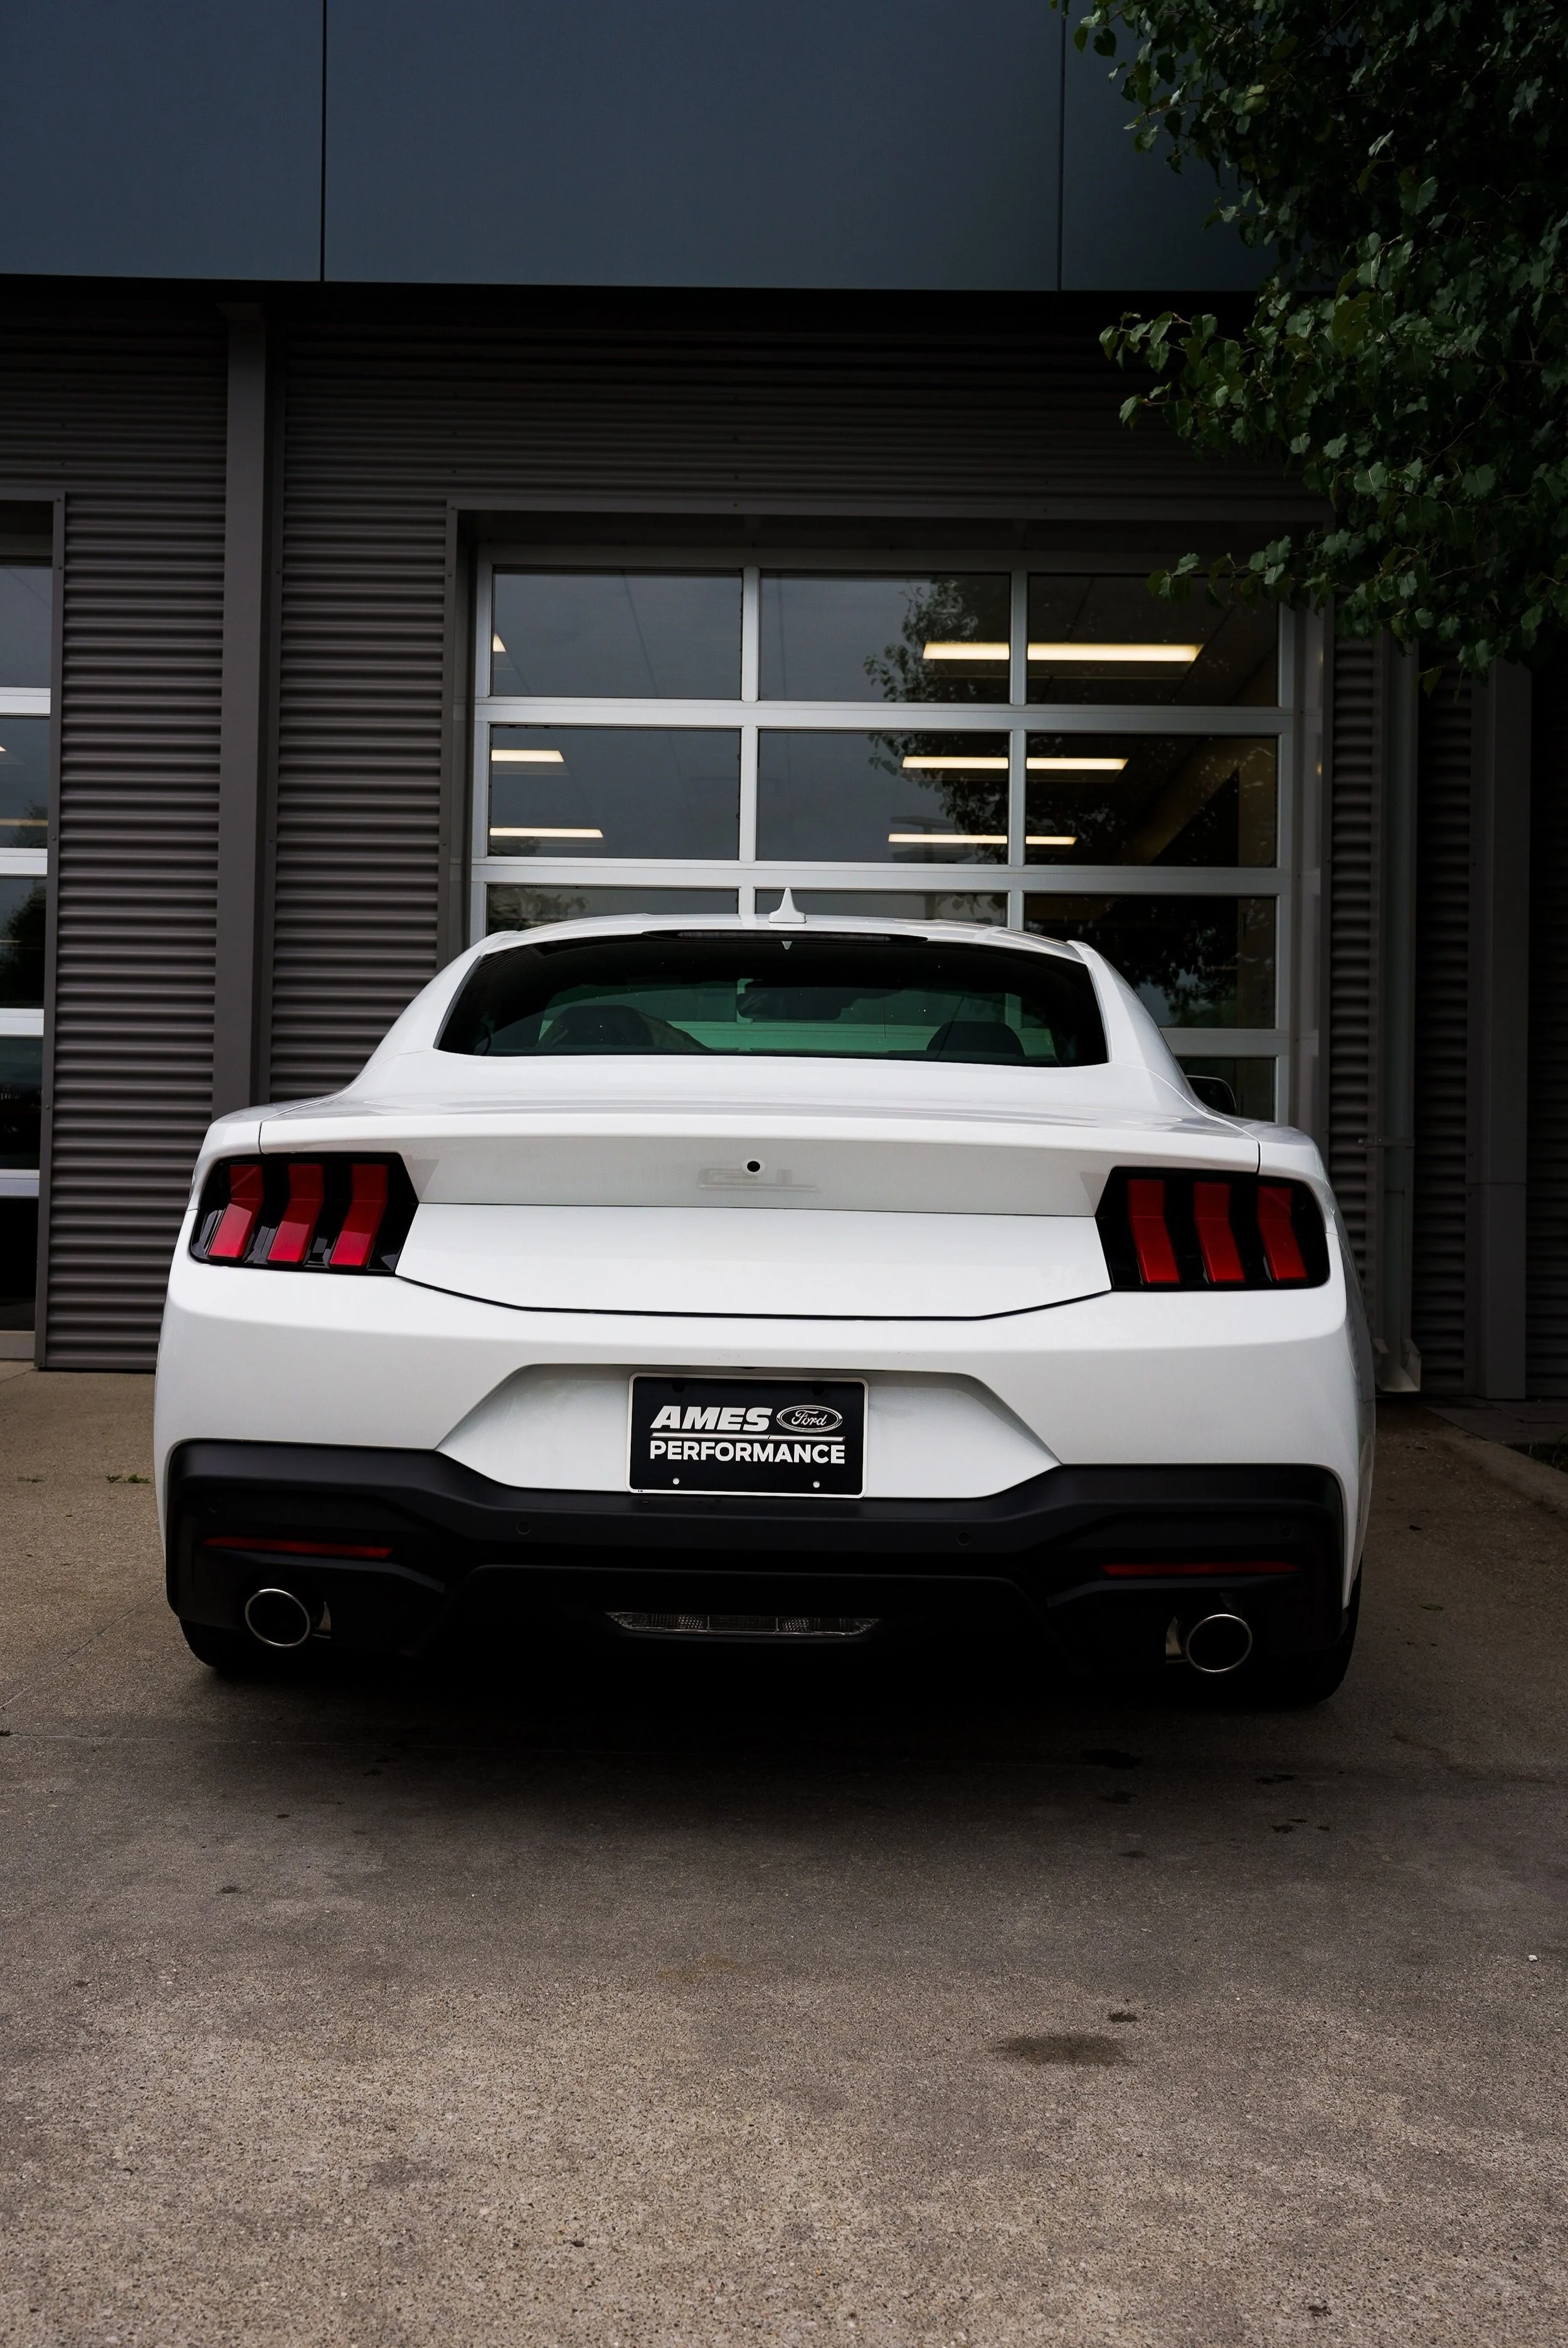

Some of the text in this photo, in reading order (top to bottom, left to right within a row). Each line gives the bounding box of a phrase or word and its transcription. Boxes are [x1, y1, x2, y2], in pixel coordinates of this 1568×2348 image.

[650, 1405, 827, 1432] AMES Ford
[650, 1440, 845, 1464] PERFORMANCE
